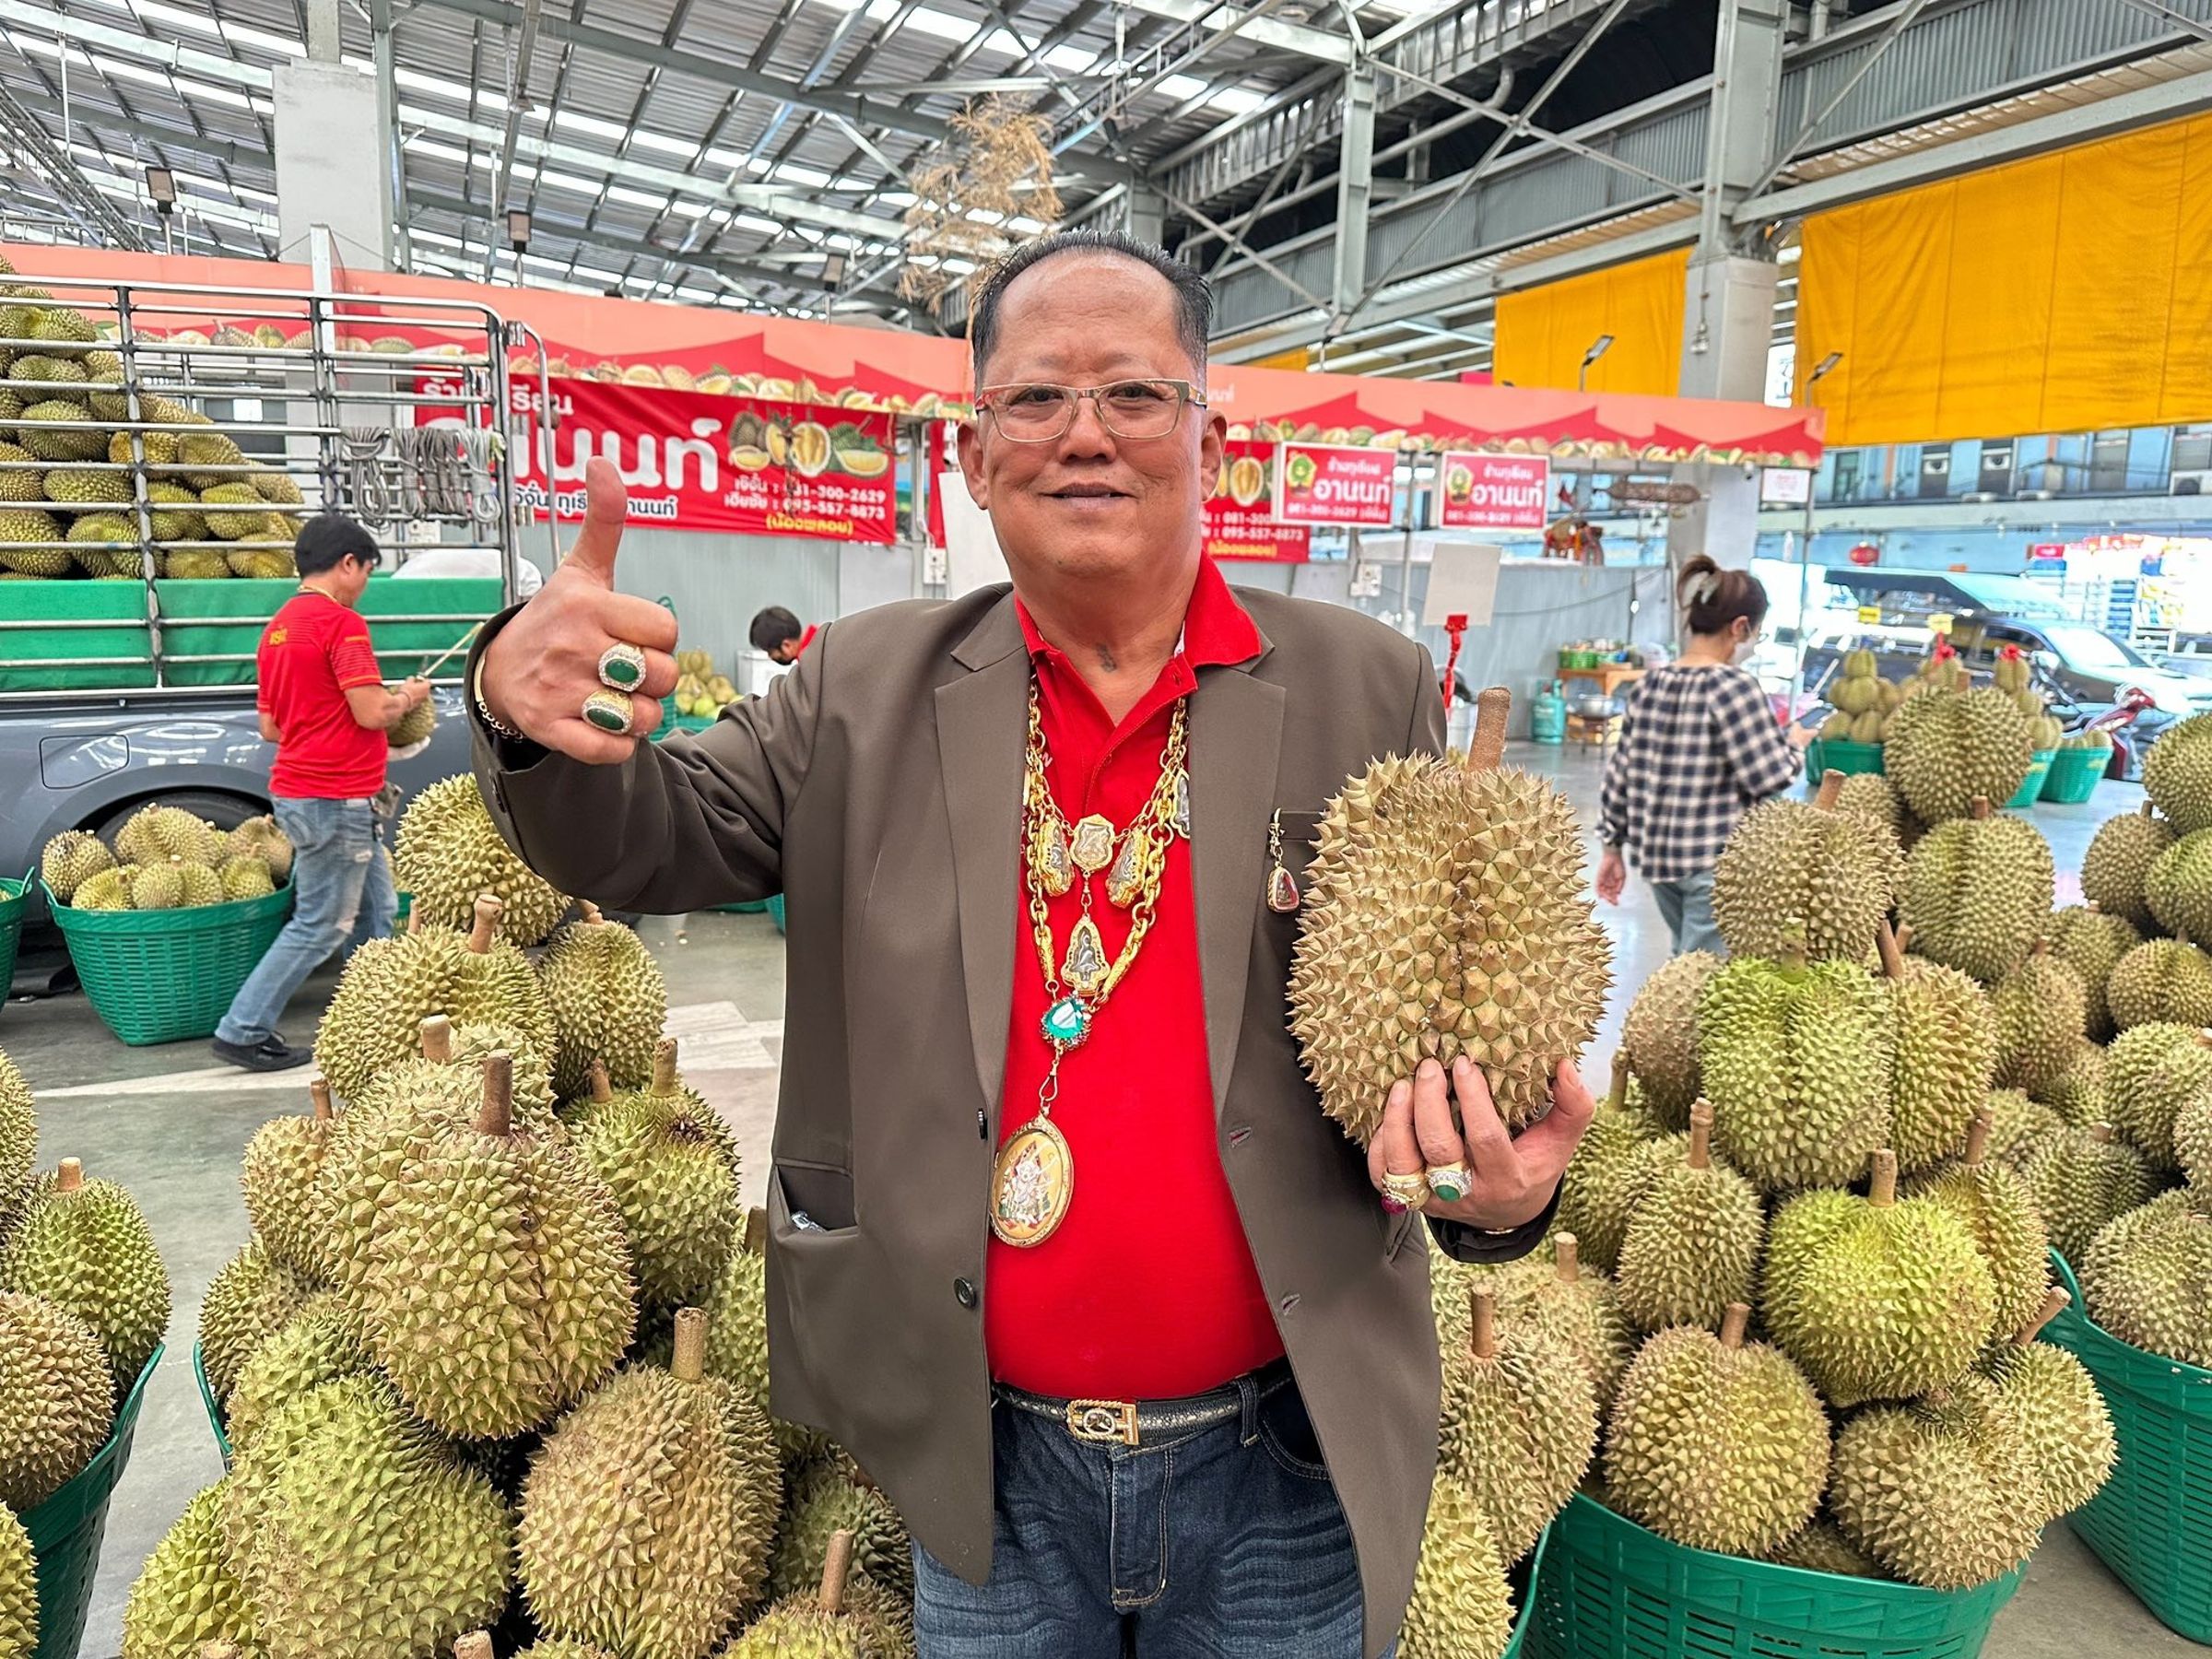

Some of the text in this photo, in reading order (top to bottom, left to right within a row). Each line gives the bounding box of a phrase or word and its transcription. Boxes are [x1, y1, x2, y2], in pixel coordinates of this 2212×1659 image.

[1313, 475, 1392, 505] อานนท์
[1470, 479, 1545, 509] อานนท์
